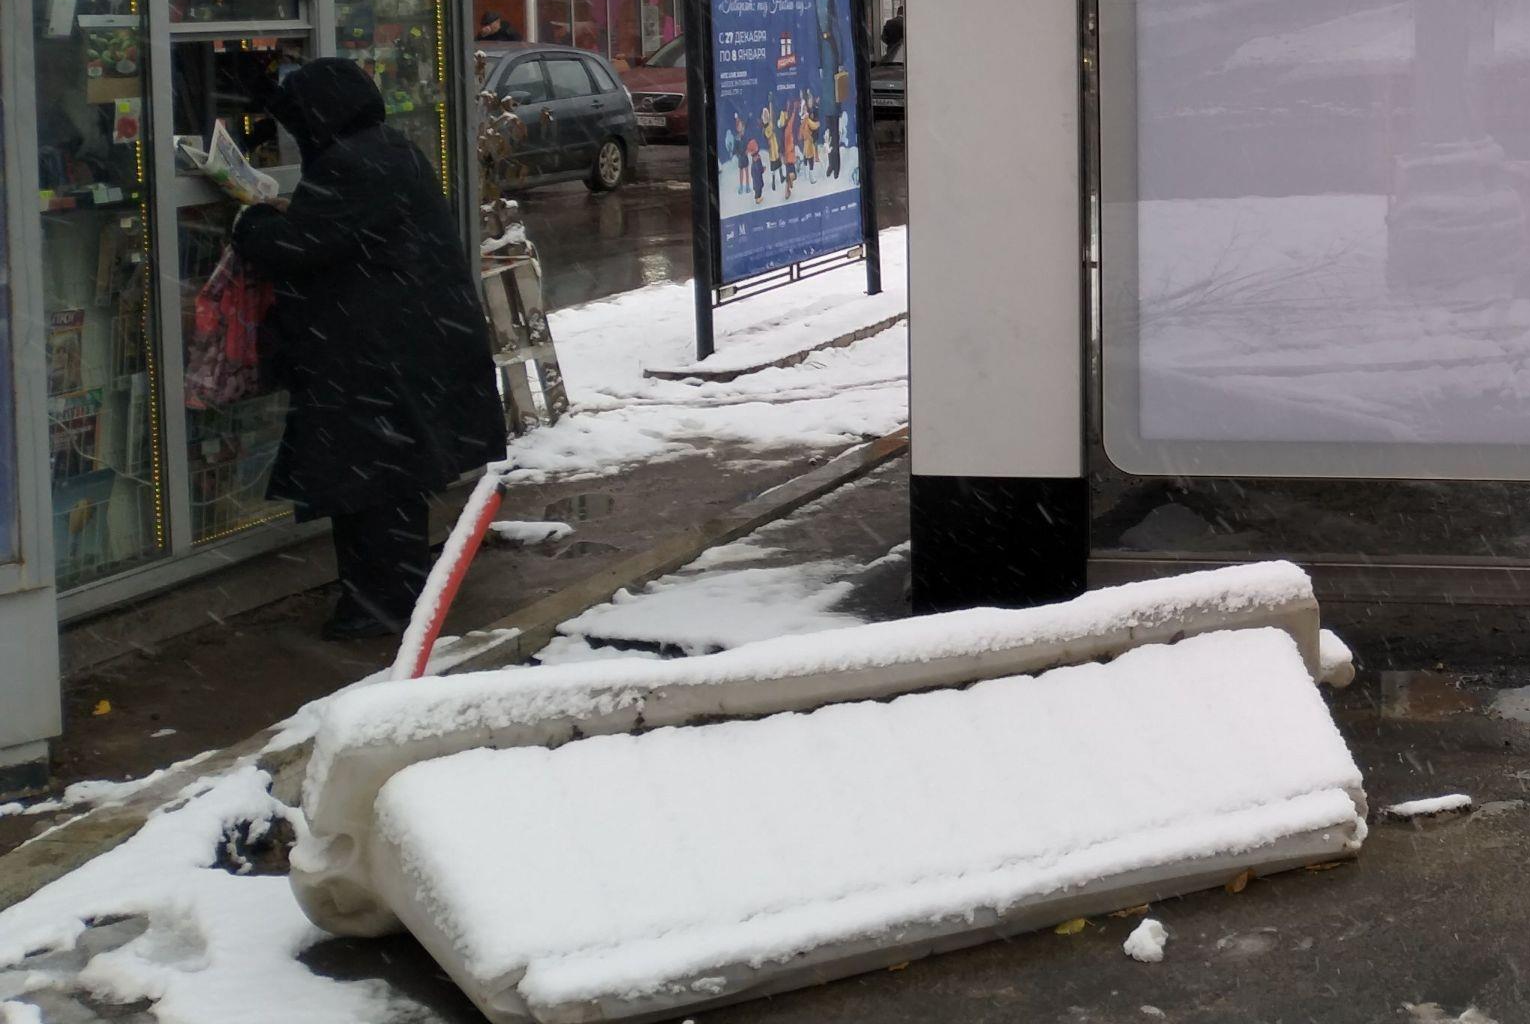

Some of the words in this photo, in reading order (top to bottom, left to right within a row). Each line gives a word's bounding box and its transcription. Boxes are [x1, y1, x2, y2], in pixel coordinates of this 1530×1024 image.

[734, 30, 767, 46] ДЕКАБРЯ
[719, 50, 731, 63] ПО
[731, 48, 737, 62] 8
[737, 47, 766, 61] ЯНВАРЯ
